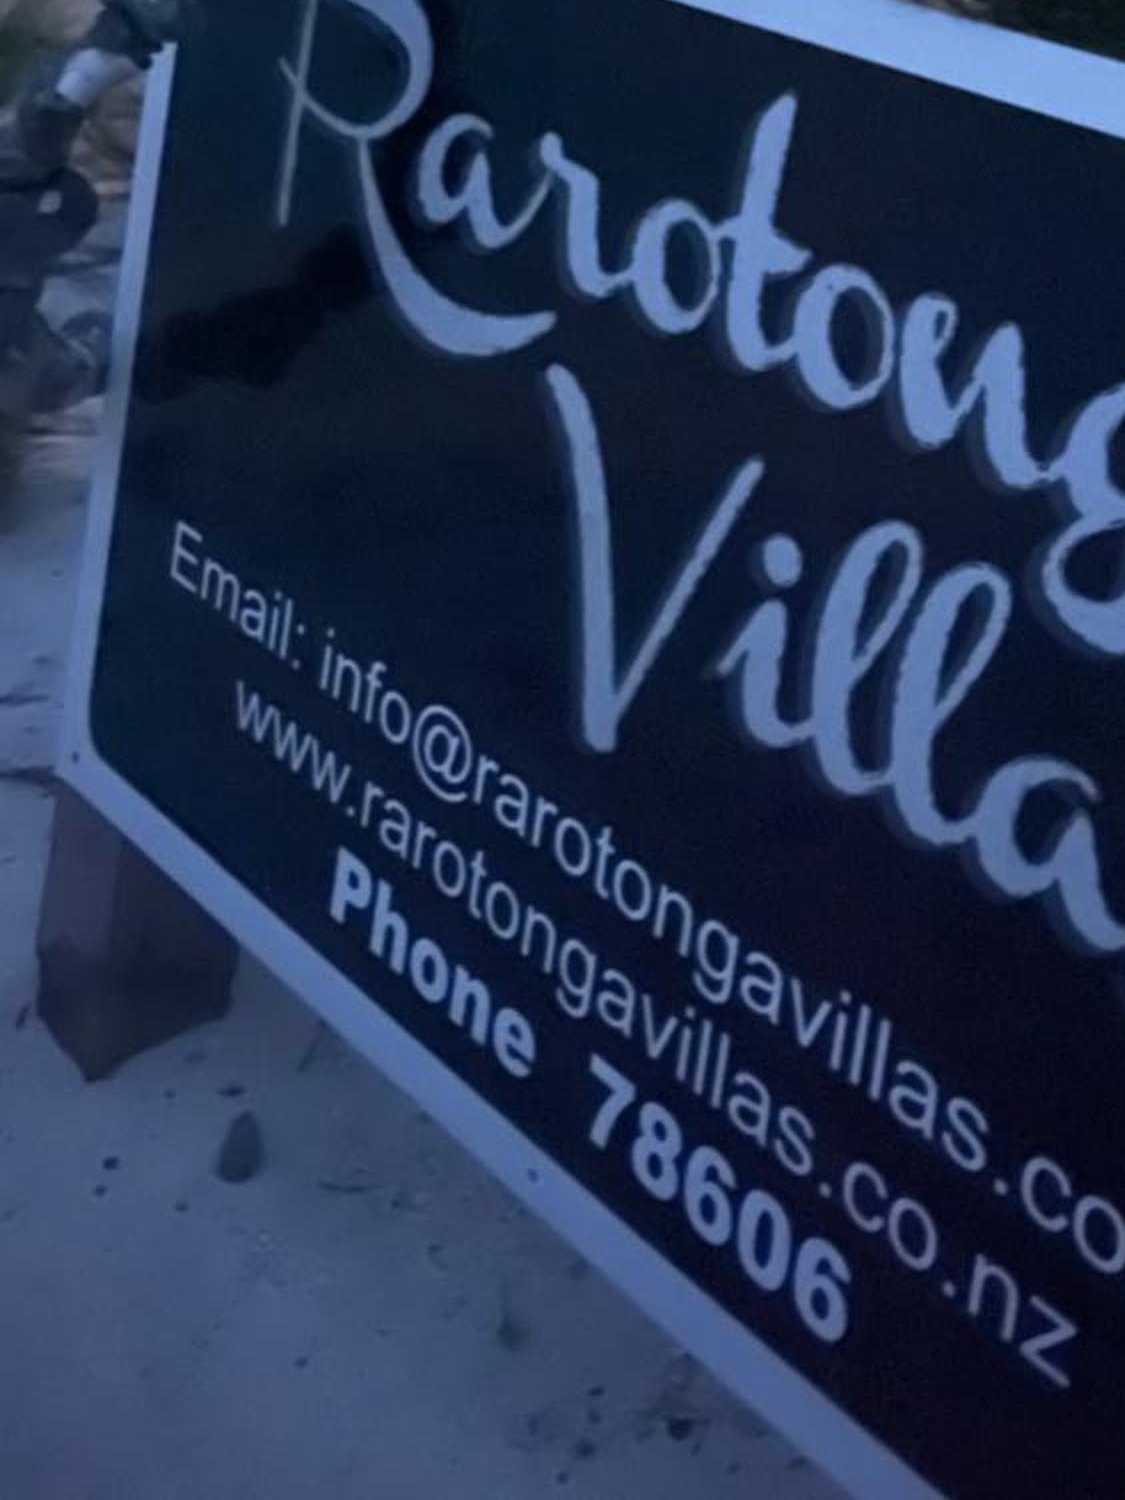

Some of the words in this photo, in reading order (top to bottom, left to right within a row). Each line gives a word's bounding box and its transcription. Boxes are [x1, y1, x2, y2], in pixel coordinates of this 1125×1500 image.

[169, 521, 306, 670] Email:
[235, 680, 1078, 1388] www.rarotongavillas.co.nz
[330, 847, 537, 1077] Phone
[589, 1053, 851, 1343] 78606
